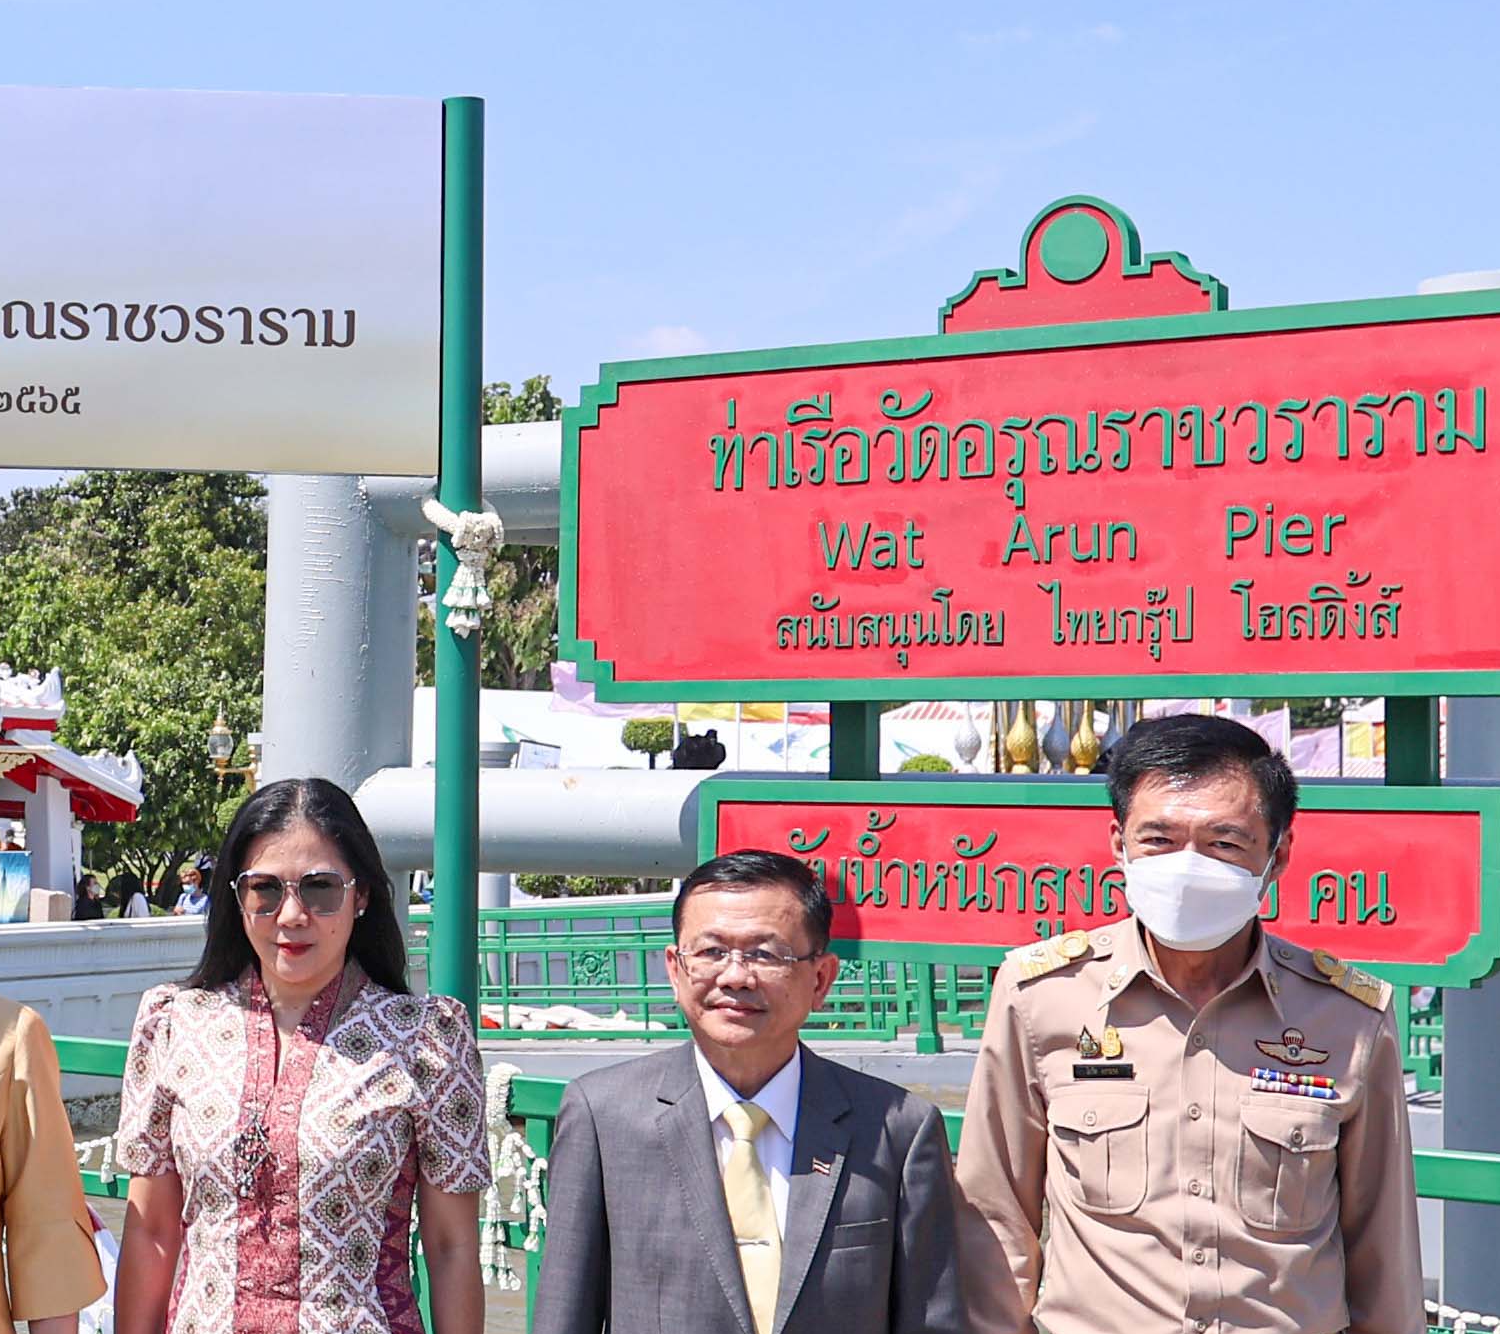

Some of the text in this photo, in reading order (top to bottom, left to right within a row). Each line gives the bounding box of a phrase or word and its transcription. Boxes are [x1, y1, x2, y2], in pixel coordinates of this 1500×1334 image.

[708, 385, 1487, 508] ท่าเรือวัดอรุณราชวราราม
[818, 503, 1347, 571] Wat Arun Pier
[775, 570, 1402, 666] สนับสนุนโดย ไทยกรุ๊ป โฮลดิ้งส์
[1309, 869, 1397, 924] คน
